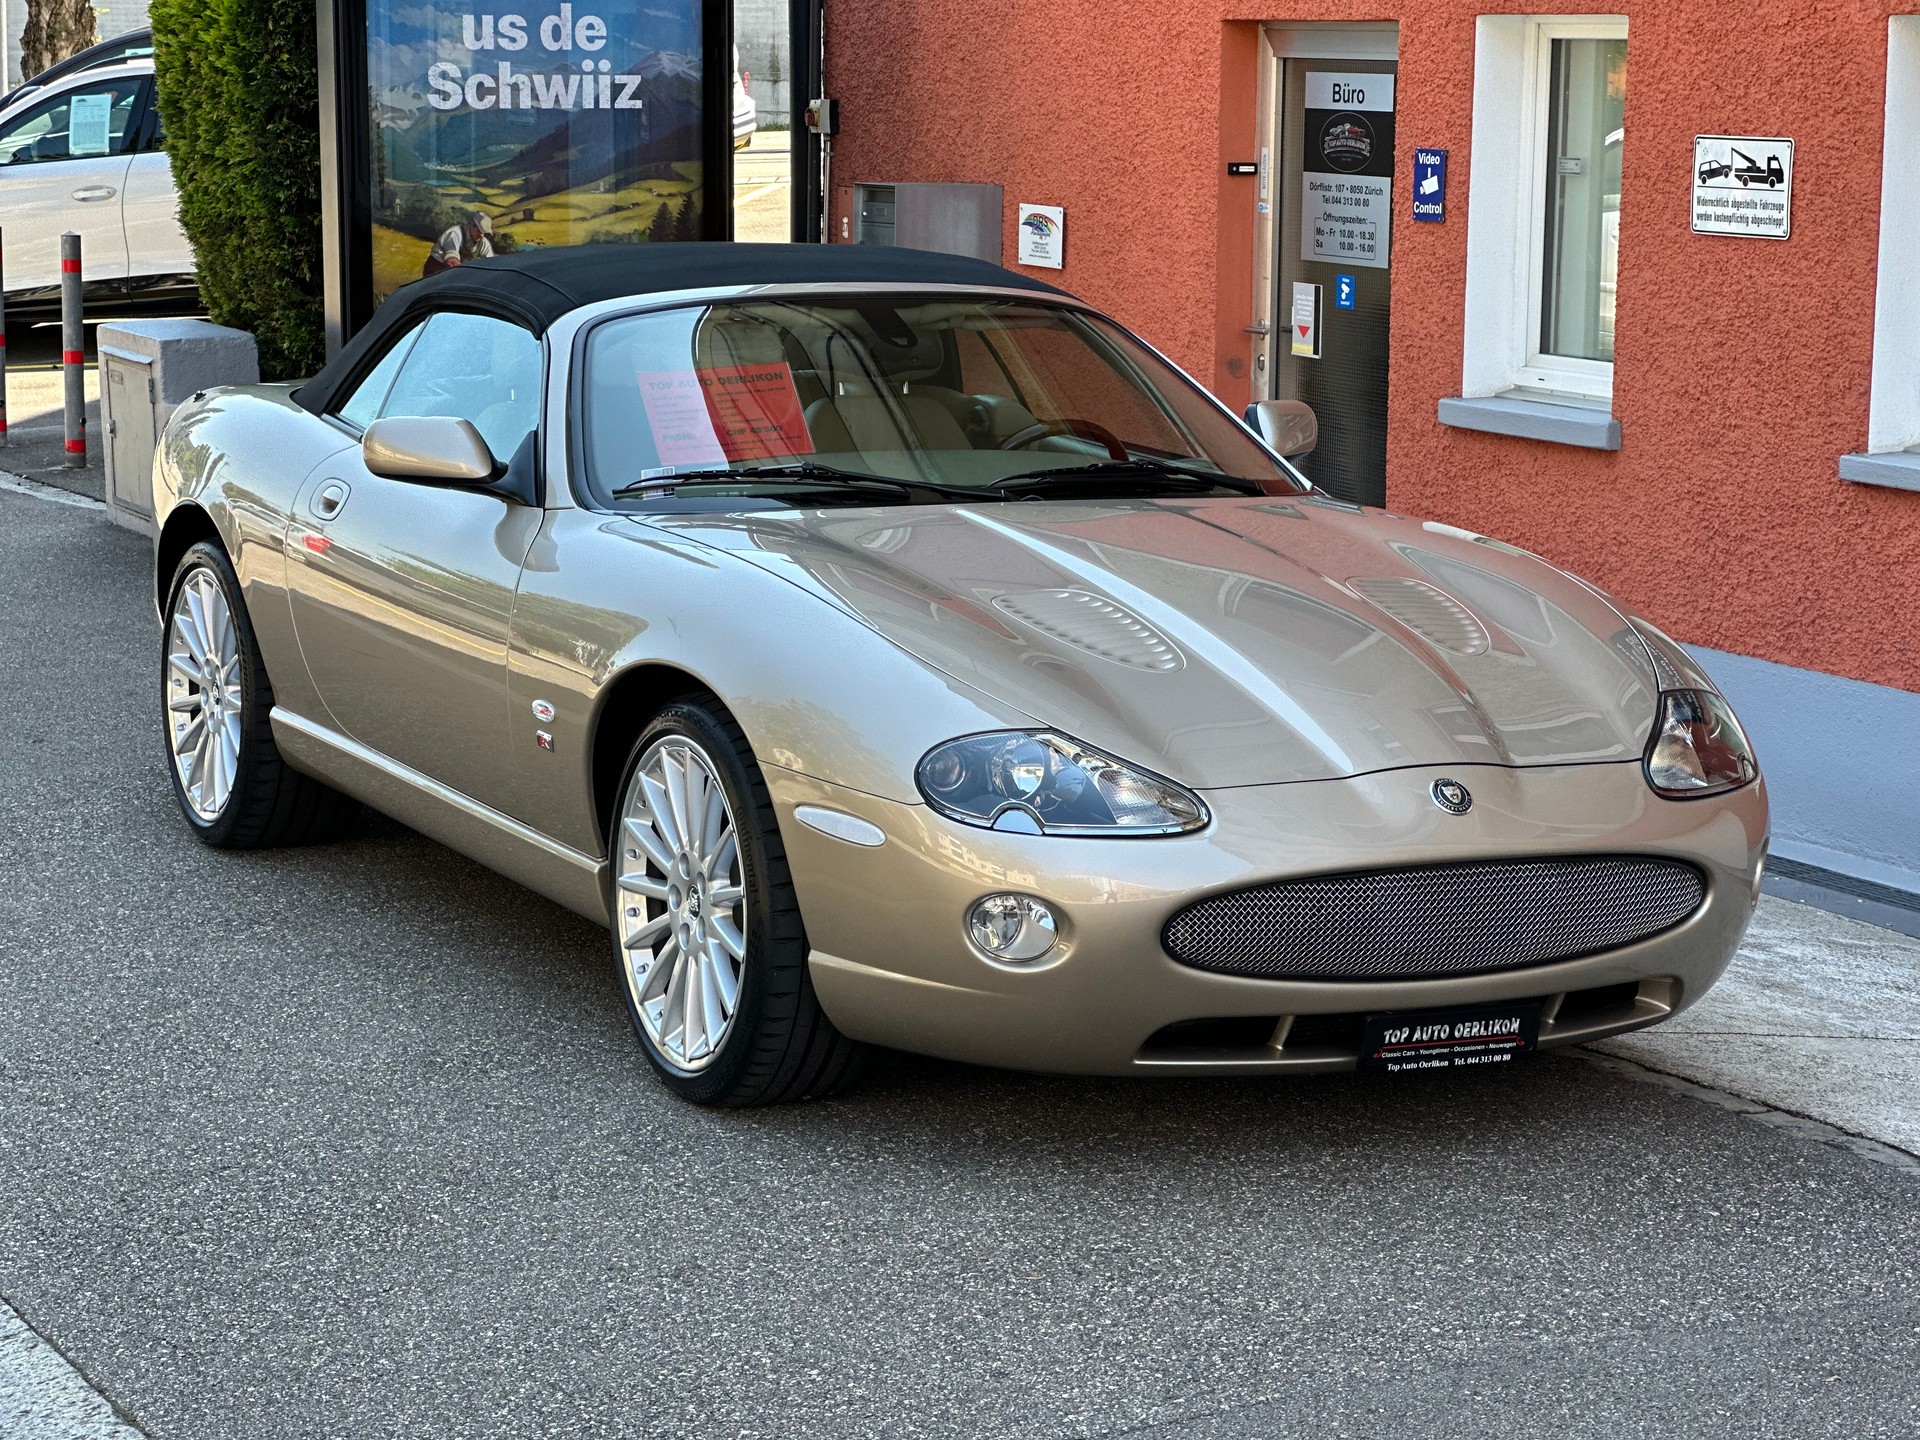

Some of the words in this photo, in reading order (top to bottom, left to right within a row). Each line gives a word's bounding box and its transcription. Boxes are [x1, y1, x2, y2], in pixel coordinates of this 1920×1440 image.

[462, 14, 528, 52] us
[540, 2, 607, 52] de
[427, 59, 642, 110] Schwiiz
[1332, 83, 1365, 104] Büro
[1418, 152, 1440, 165] Video
[1310, 182, 1333, 192] Dörflistr.
[1335, 184, 1345, 192] 107
[1350, 185, 1363, 194] 8050
[1364, 186, 1383, 196] Zürich
[1343, 197, 1353, 206] 313
[1354, 198, 1361, 207] 00
[1362, 198, 1370, 207] 80
[1414, 202, 1442, 215] Control
[1696, 196, 1729, 208] Widerrechtlich
[1731, 198, 1758, 211] abgestellte
[1759, 199, 1784, 214] Fahrzeuge
[1323, 211, 1368, 225] Öffnungszeiten:
[1696, 211, 1712, 221] werden
[1714, 211, 1749, 227] kostenpflichtig
[1751, 214, 1784, 229] abgeschleppt
[1316, 227, 1325, 236] Mo
[1329, 228, 1336, 237] Fr
[1339, 229, 1354, 239] 10.00
[1359, 231, 1374, 240] 18.30
[1316, 239, 1323, 248] Sa
[1339, 242, 1354, 251] 10.00
[1359, 243, 1374, 253] 16.00
[648, 381, 675, 390] TOP
[717, 372, 784, 386] OERLIKON
[1384, 1027, 1409, 1044] TOP
[1412, 1024, 1450, 1041] AUTO
[1454, 1017, 1520, 1038] OERLIKON
[1387, 1063, 1400, 1072] Top
[1419, 1060, 1449, 1068] Oerlikon
[1480, 1055, 1492, 1063] 313
